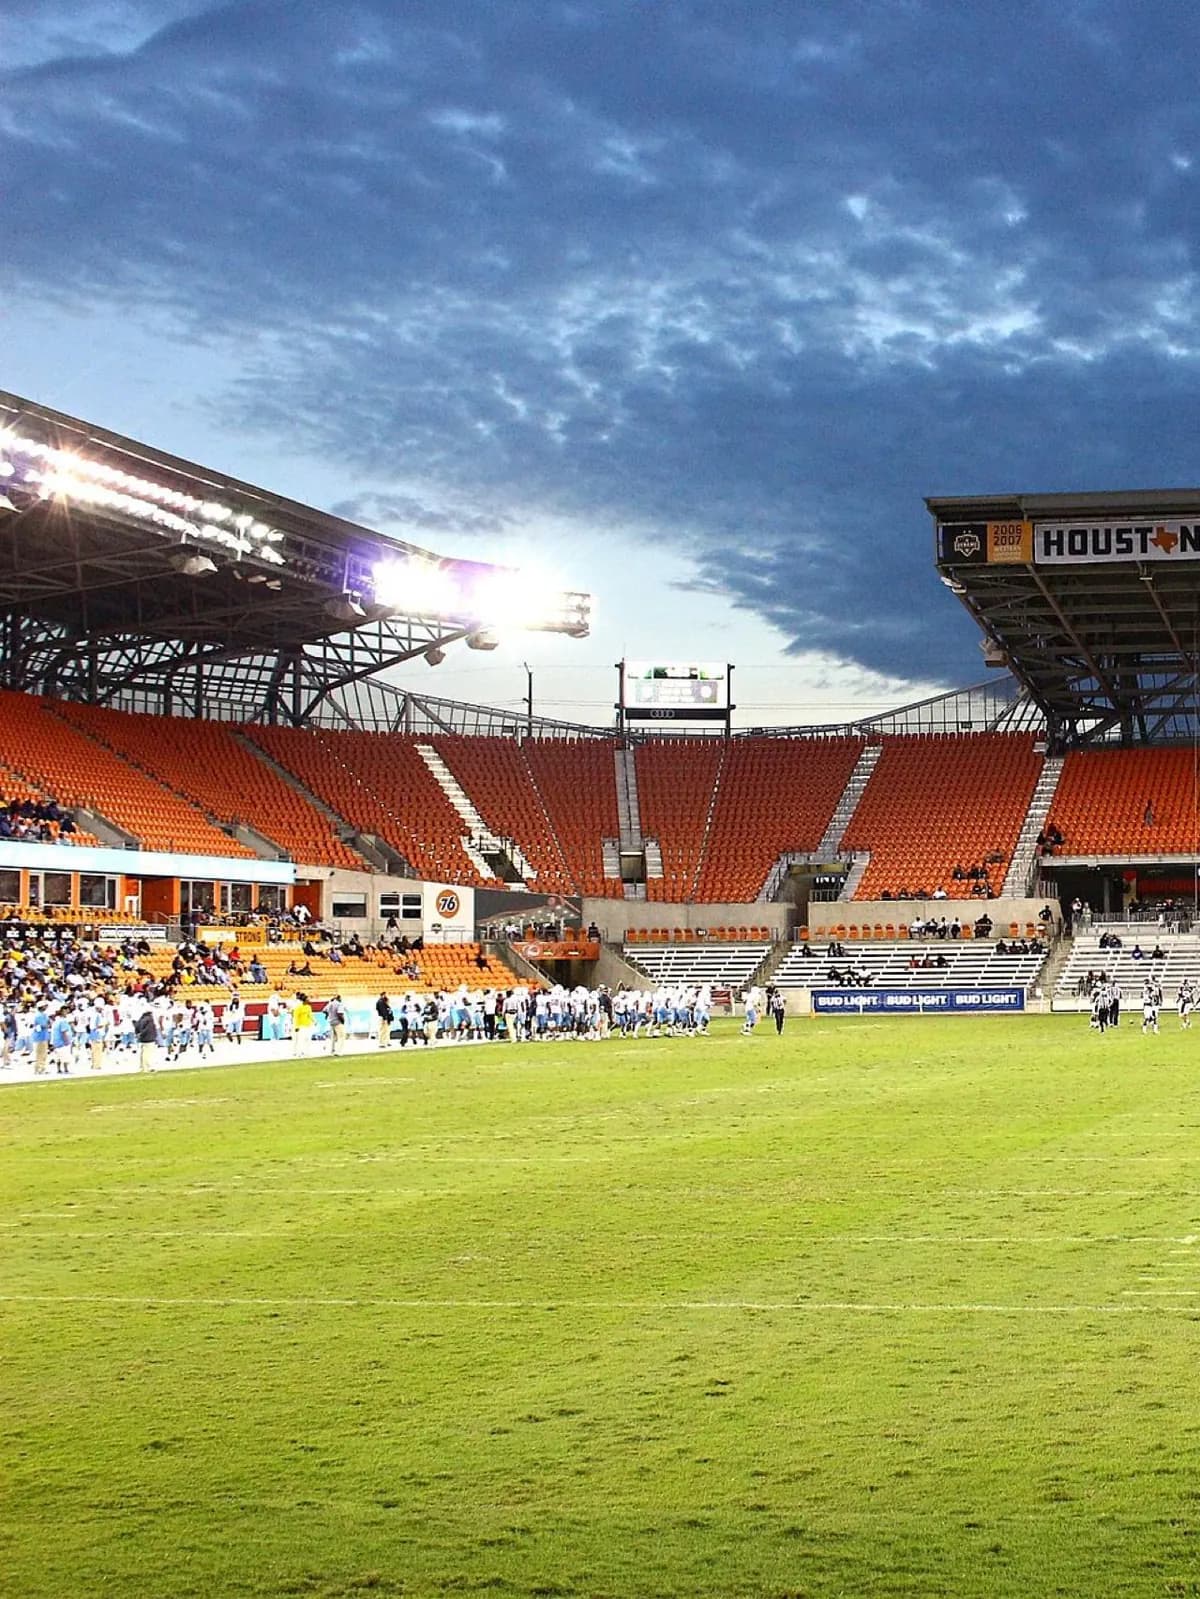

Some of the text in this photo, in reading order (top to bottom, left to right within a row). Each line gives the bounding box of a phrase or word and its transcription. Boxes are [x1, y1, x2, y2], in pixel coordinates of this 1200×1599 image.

[993, 525, 1022, 535] 2006
[993, 536, 1022, 546] 2007
[1043, 525, 1200, 556] HOUSTN
[441, 896, 456, 911] 76
[818, 996, 843, 1006] BUD
[887, 995, 911, 1005] BUD
[957, 994, 1017, 1004] BUD LIGHT
